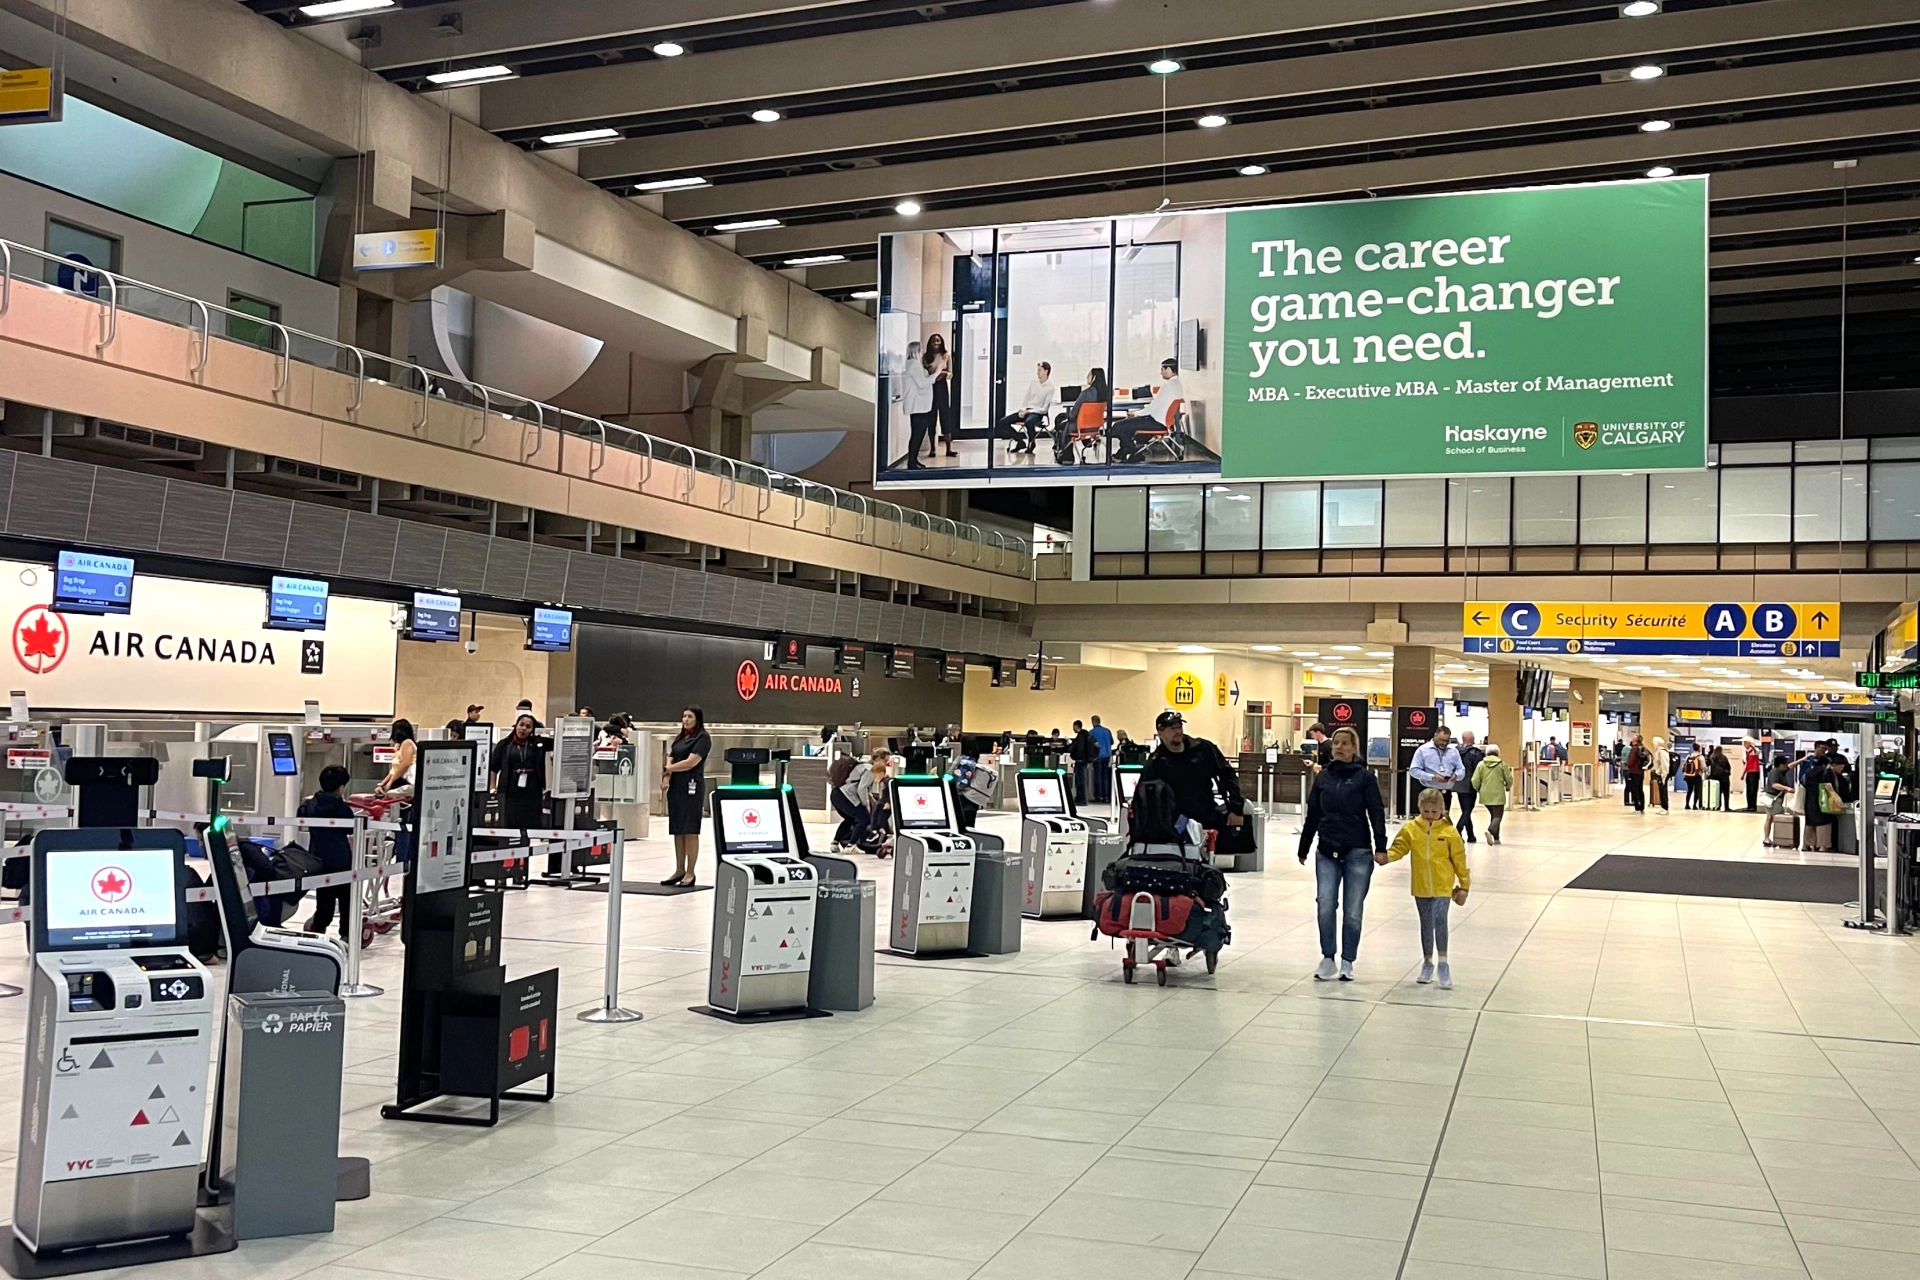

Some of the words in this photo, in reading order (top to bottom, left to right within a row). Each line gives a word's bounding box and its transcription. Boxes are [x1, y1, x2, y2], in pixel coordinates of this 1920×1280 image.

[1251, 239, 1343, 278] The
[1355, 234, 1511, 271] career
[1250, 275, 1621, 333] game-changer
[1249, 337, 1341, 378] you
[1353, 320, 1486, 364] need.
[1247, 386, 1290, 402] MBA
[1305, 383, 1391, 400] Executive
[1395, 381, 1439, 397] MBA
[1455, 378, 1519, 394] Master
[1522, 376, 1542, 392] of
[1545, 372, 1674, 393] Management
[1602, 421, 1667, 431] UNIVERSITY
[1670, 421, 1686, 430] OF
[1445, 424, 1548, 444] Haskayne
[1601, 430, 1686, 445] CALGARY
[1445, 446, 1475, 455] School
[1476, 446, 1486, 454] of
[1487, 445, 1526, 454] Business
[77, 558, 92, 568] AIR
[93, 560, 128, 572] CANADA
[298, 584, 324, 592] CANADA
[1511, 609, 1529, 631] C
[1556, 613, 1618, 629] Security
[1625, 613, 1687, 628] Sécurité
[1714, 610, 1736, 632] A
[1765, 610, 1784, 632] B
[89, 630, 145, 658] AIR
[154, 634, 276, 665] CANADA
[764, 674, 788, 690] AIR
[790, 675, 842, 693] CANADA
[1861, 673, 1880, 687] EXIT
[79, 908, 98, 916] AIR
[100, 907, 145, 915] CANADA
[720, 961, 732, 994] YYC
[289, 1011, 329, 1022] PAPER
[289, 1022, 332, 1033] PAPIER
[66, 1160, 94, 1171] YYC
